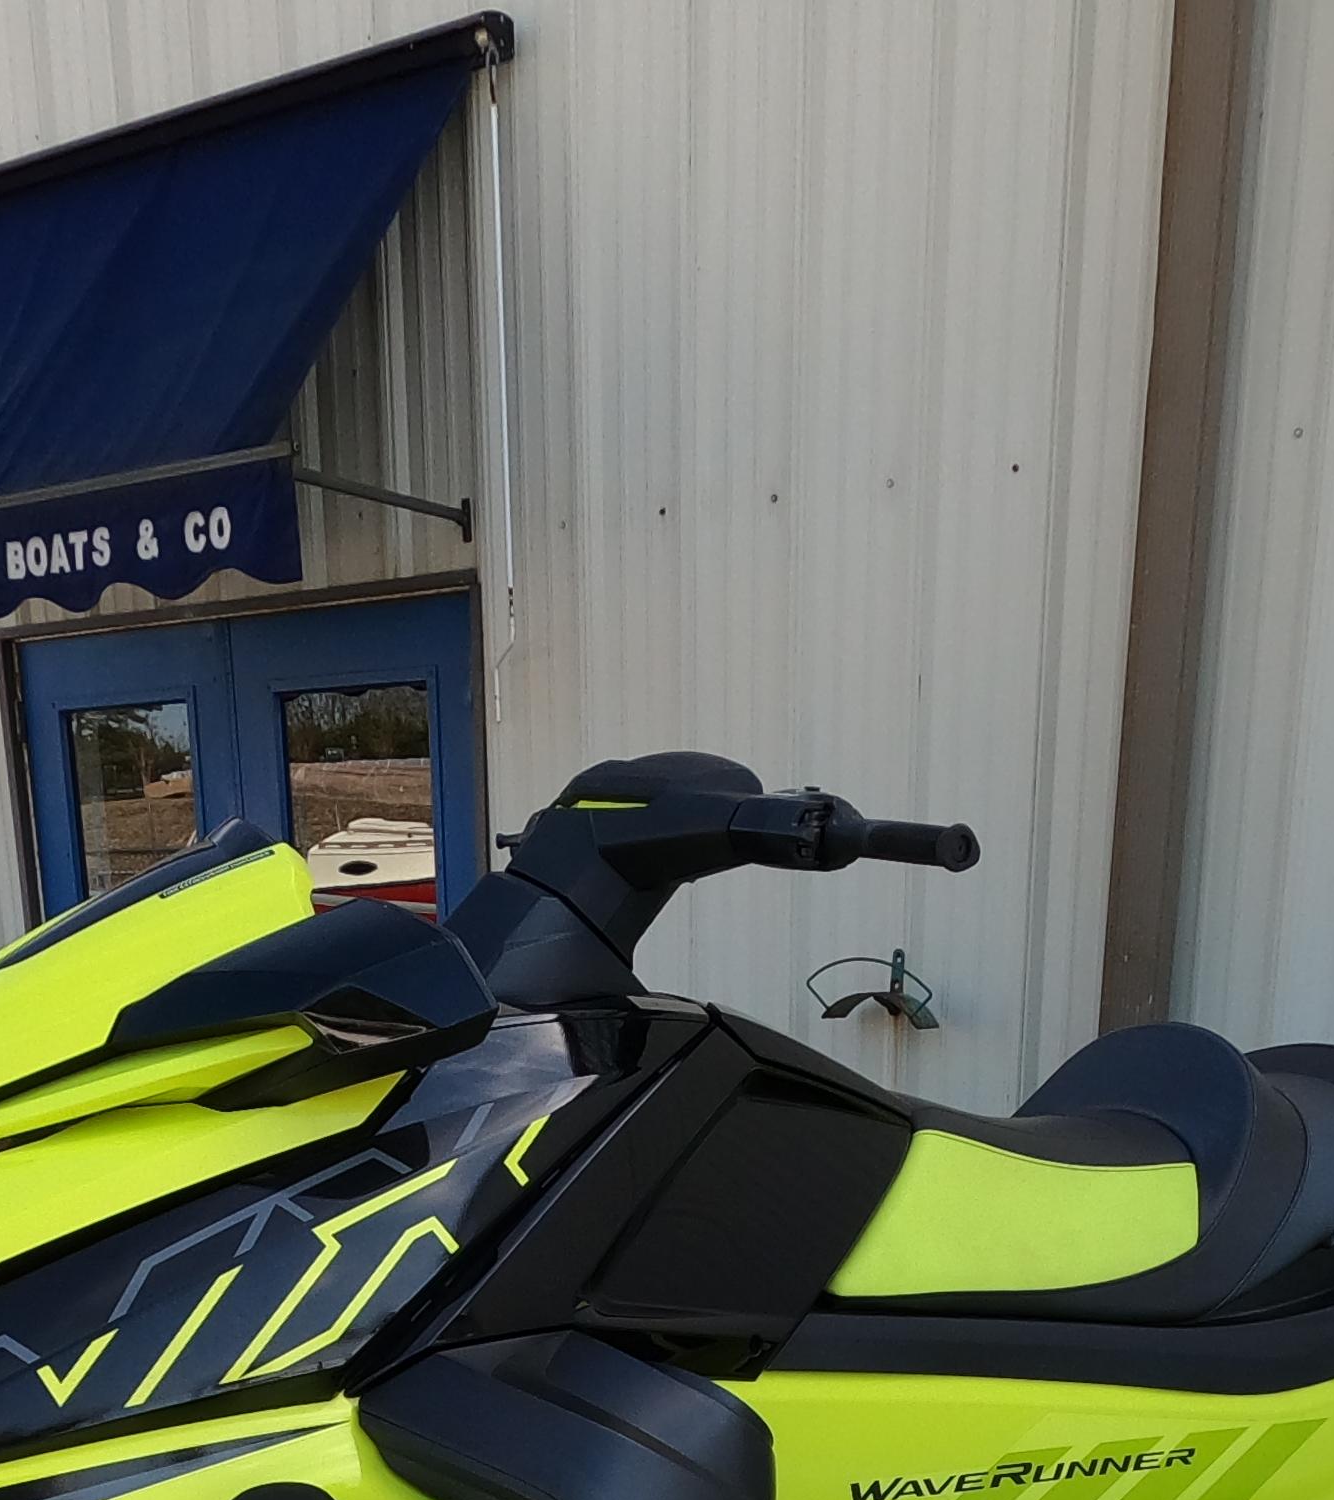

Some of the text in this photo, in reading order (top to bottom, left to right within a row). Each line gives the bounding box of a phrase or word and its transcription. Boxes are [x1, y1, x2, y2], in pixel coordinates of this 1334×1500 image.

[5, 526, 112, 580] BOATS
[135, 518, 159, 560] &
[183, 506, 232, 554] CO
